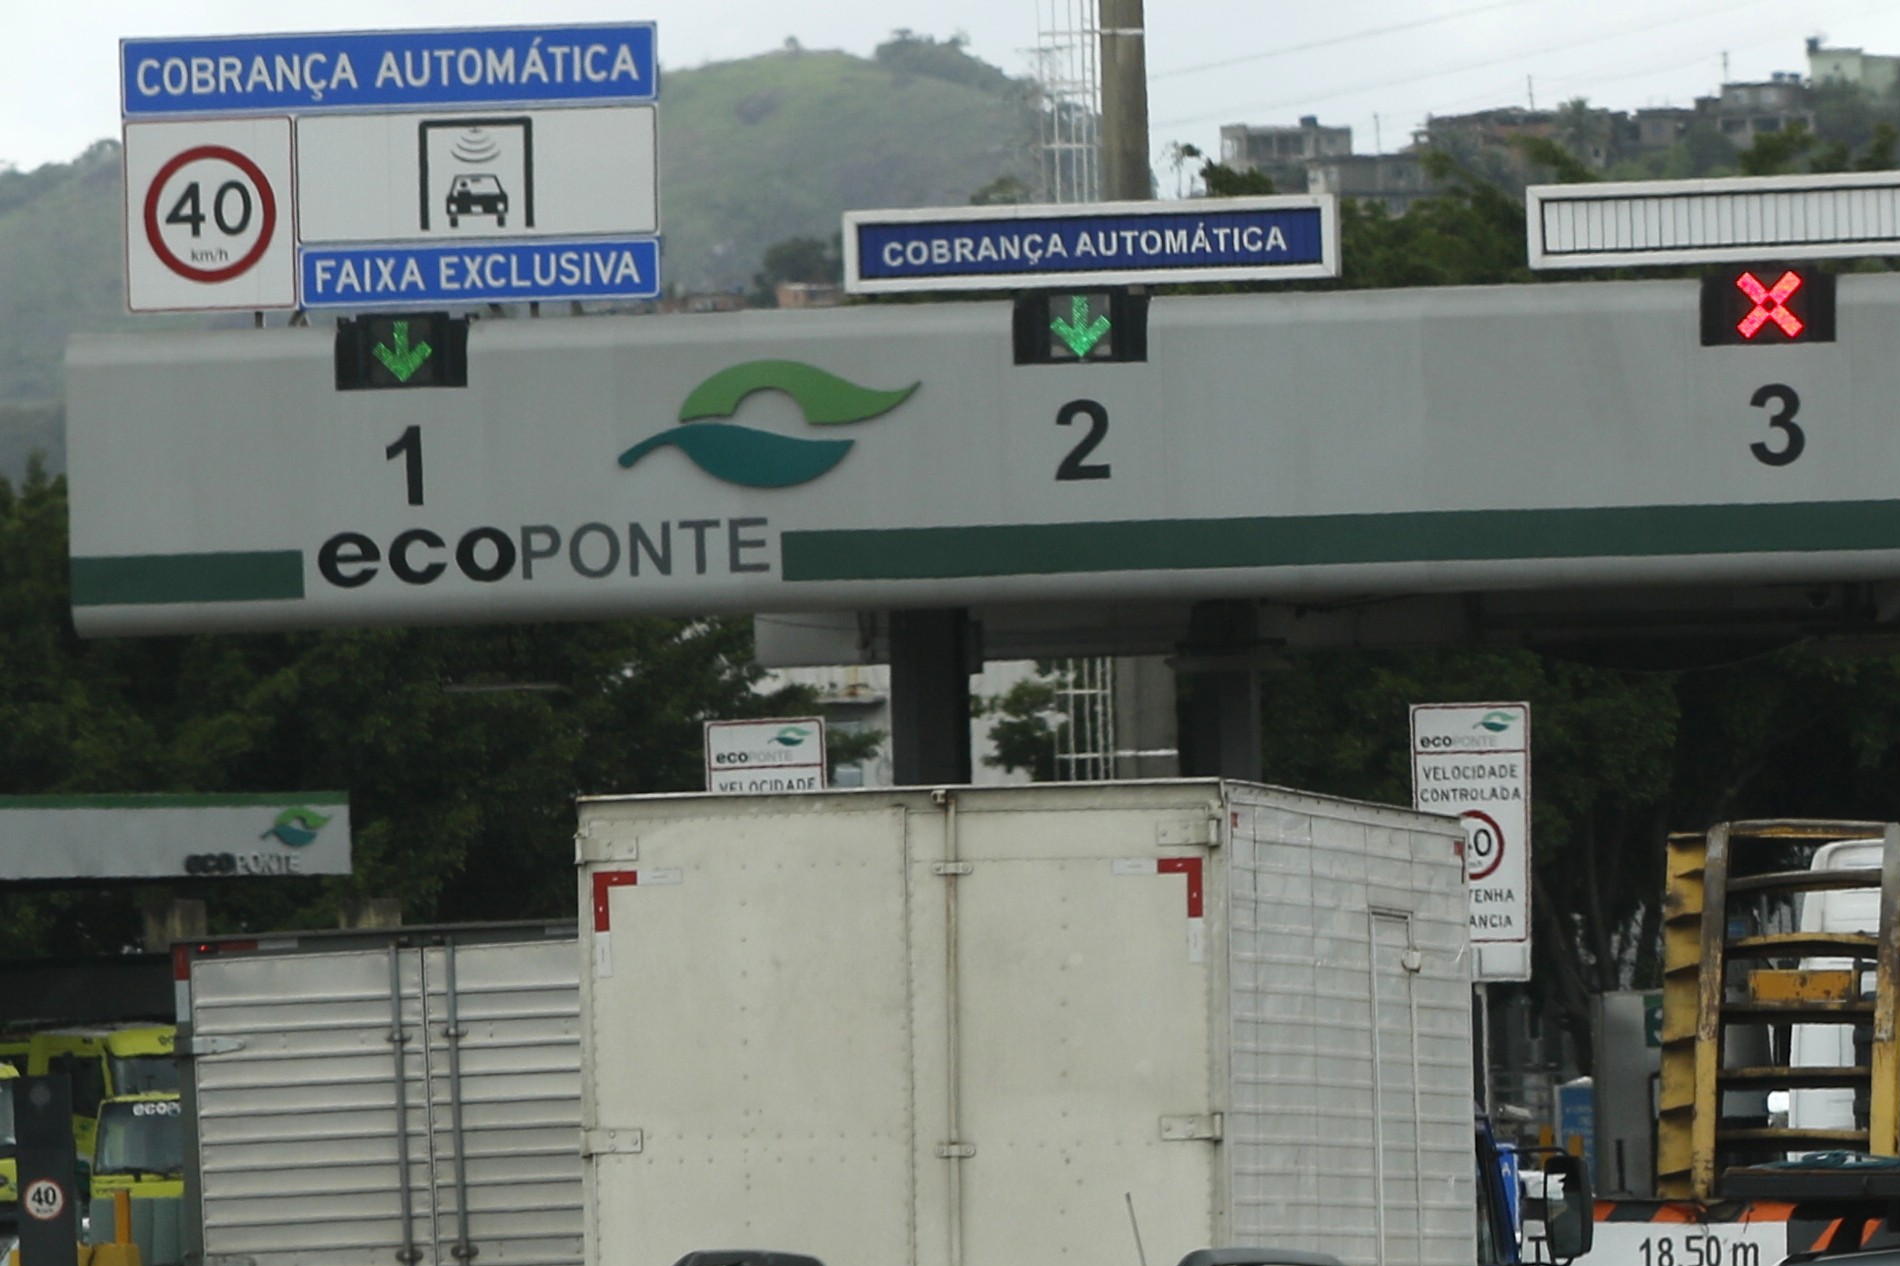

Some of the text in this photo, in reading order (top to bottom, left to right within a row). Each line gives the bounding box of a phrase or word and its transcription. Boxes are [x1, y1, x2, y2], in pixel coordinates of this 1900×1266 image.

[136, 38, 639, 101] COBRANÇA AUTOMÁTICA
[165, 179, 252, 238] 40
[190, 246, 230, 264] km/h
[883, 223, 1287, 267] COBRANÇA AUTOMÁTICA
[315, 250, 640, 294] FAIXA EXCLUSIVA
[1055, 399, 1111, 481] 2
[1749, 383, 1806, 467] 3
[384, 425, 424, 507] 1
[318, 518, 772, 588] ecoPONTE
[1420, 787, 1522, 802] CONTROLADA
[1423, 764, 1518, 781] VELOCIDADE
[31, 1187, 57, 1206] 40
